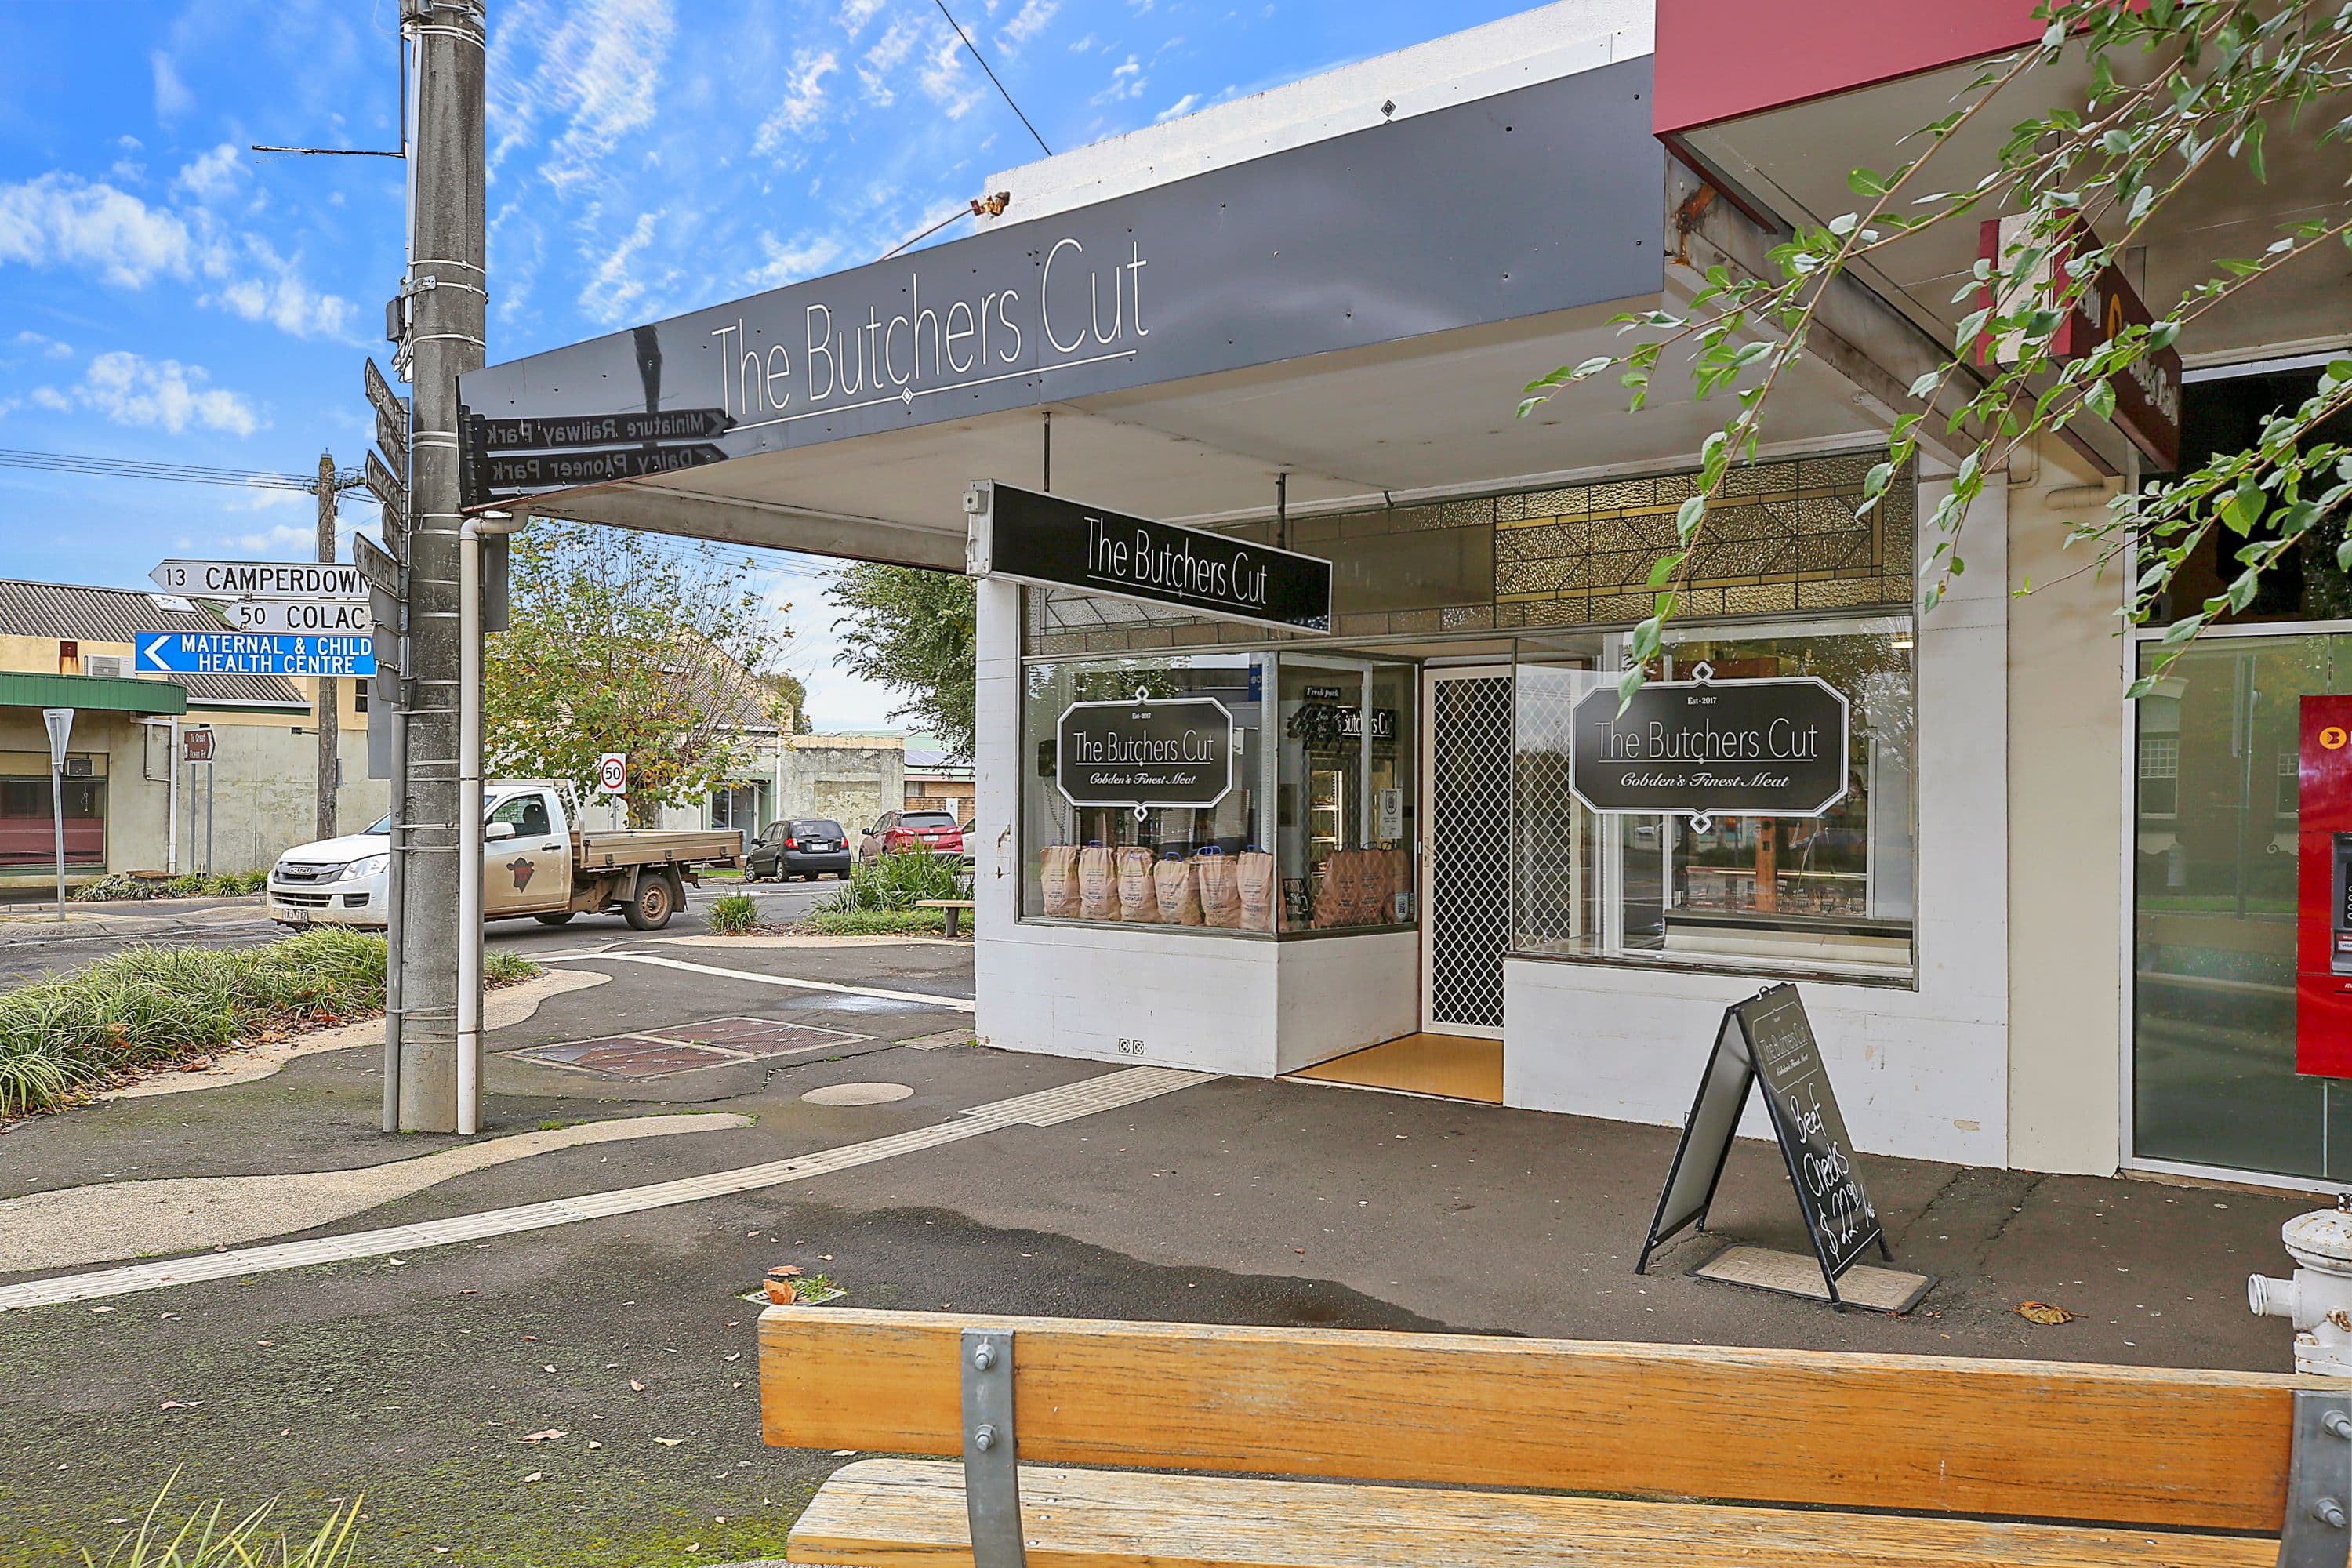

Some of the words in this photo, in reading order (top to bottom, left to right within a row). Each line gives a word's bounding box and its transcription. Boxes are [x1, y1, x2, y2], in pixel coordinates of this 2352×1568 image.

[711, 318, 791, 419] The
[805, 273, 1022, 402] Butchers
[1041, 238, 1149, 353] Cut
[1083, 516, 1127, 577] The
[1135, 528, 1227, 596] Butchers
[1232, 551, 1268, 605] Cut
[165, 568, 187, 586] 13
[240, 607, 266, 626] 50
[286, 605, 365, 630] COLAC
[181, 634, 284, 655] MATERNAL
[294, 636, 306, 655] &
[317, 637, 372, 656] CHILD
[199, 654, 273, 673] HEALTH
[283, 655, 355, 674] CENTRE
[1073, 730, 1103, 762] The
[1106, 729, 1178, 763] Butchers
[1182, 730, 1214, 762] Cut
[1595, 720, 1639, 758] The
[1648, 717, 1760, 758] Butchers
[1768, 717, 1818, 758] Cut
[606, 767, 621, 780] 50
[1090, 772, 1132, 785] Cobden's
[1133, 772, 1166, 785] Finest
[1165, 772, 1197, 785] Meat
[1621, 771, 1686, 787] Cobden's
[1689, 771, 1740, 787] Finest
[1740, 771, 1790, 788] Meat
[1790, 1082, 1827, 1144] Beef
